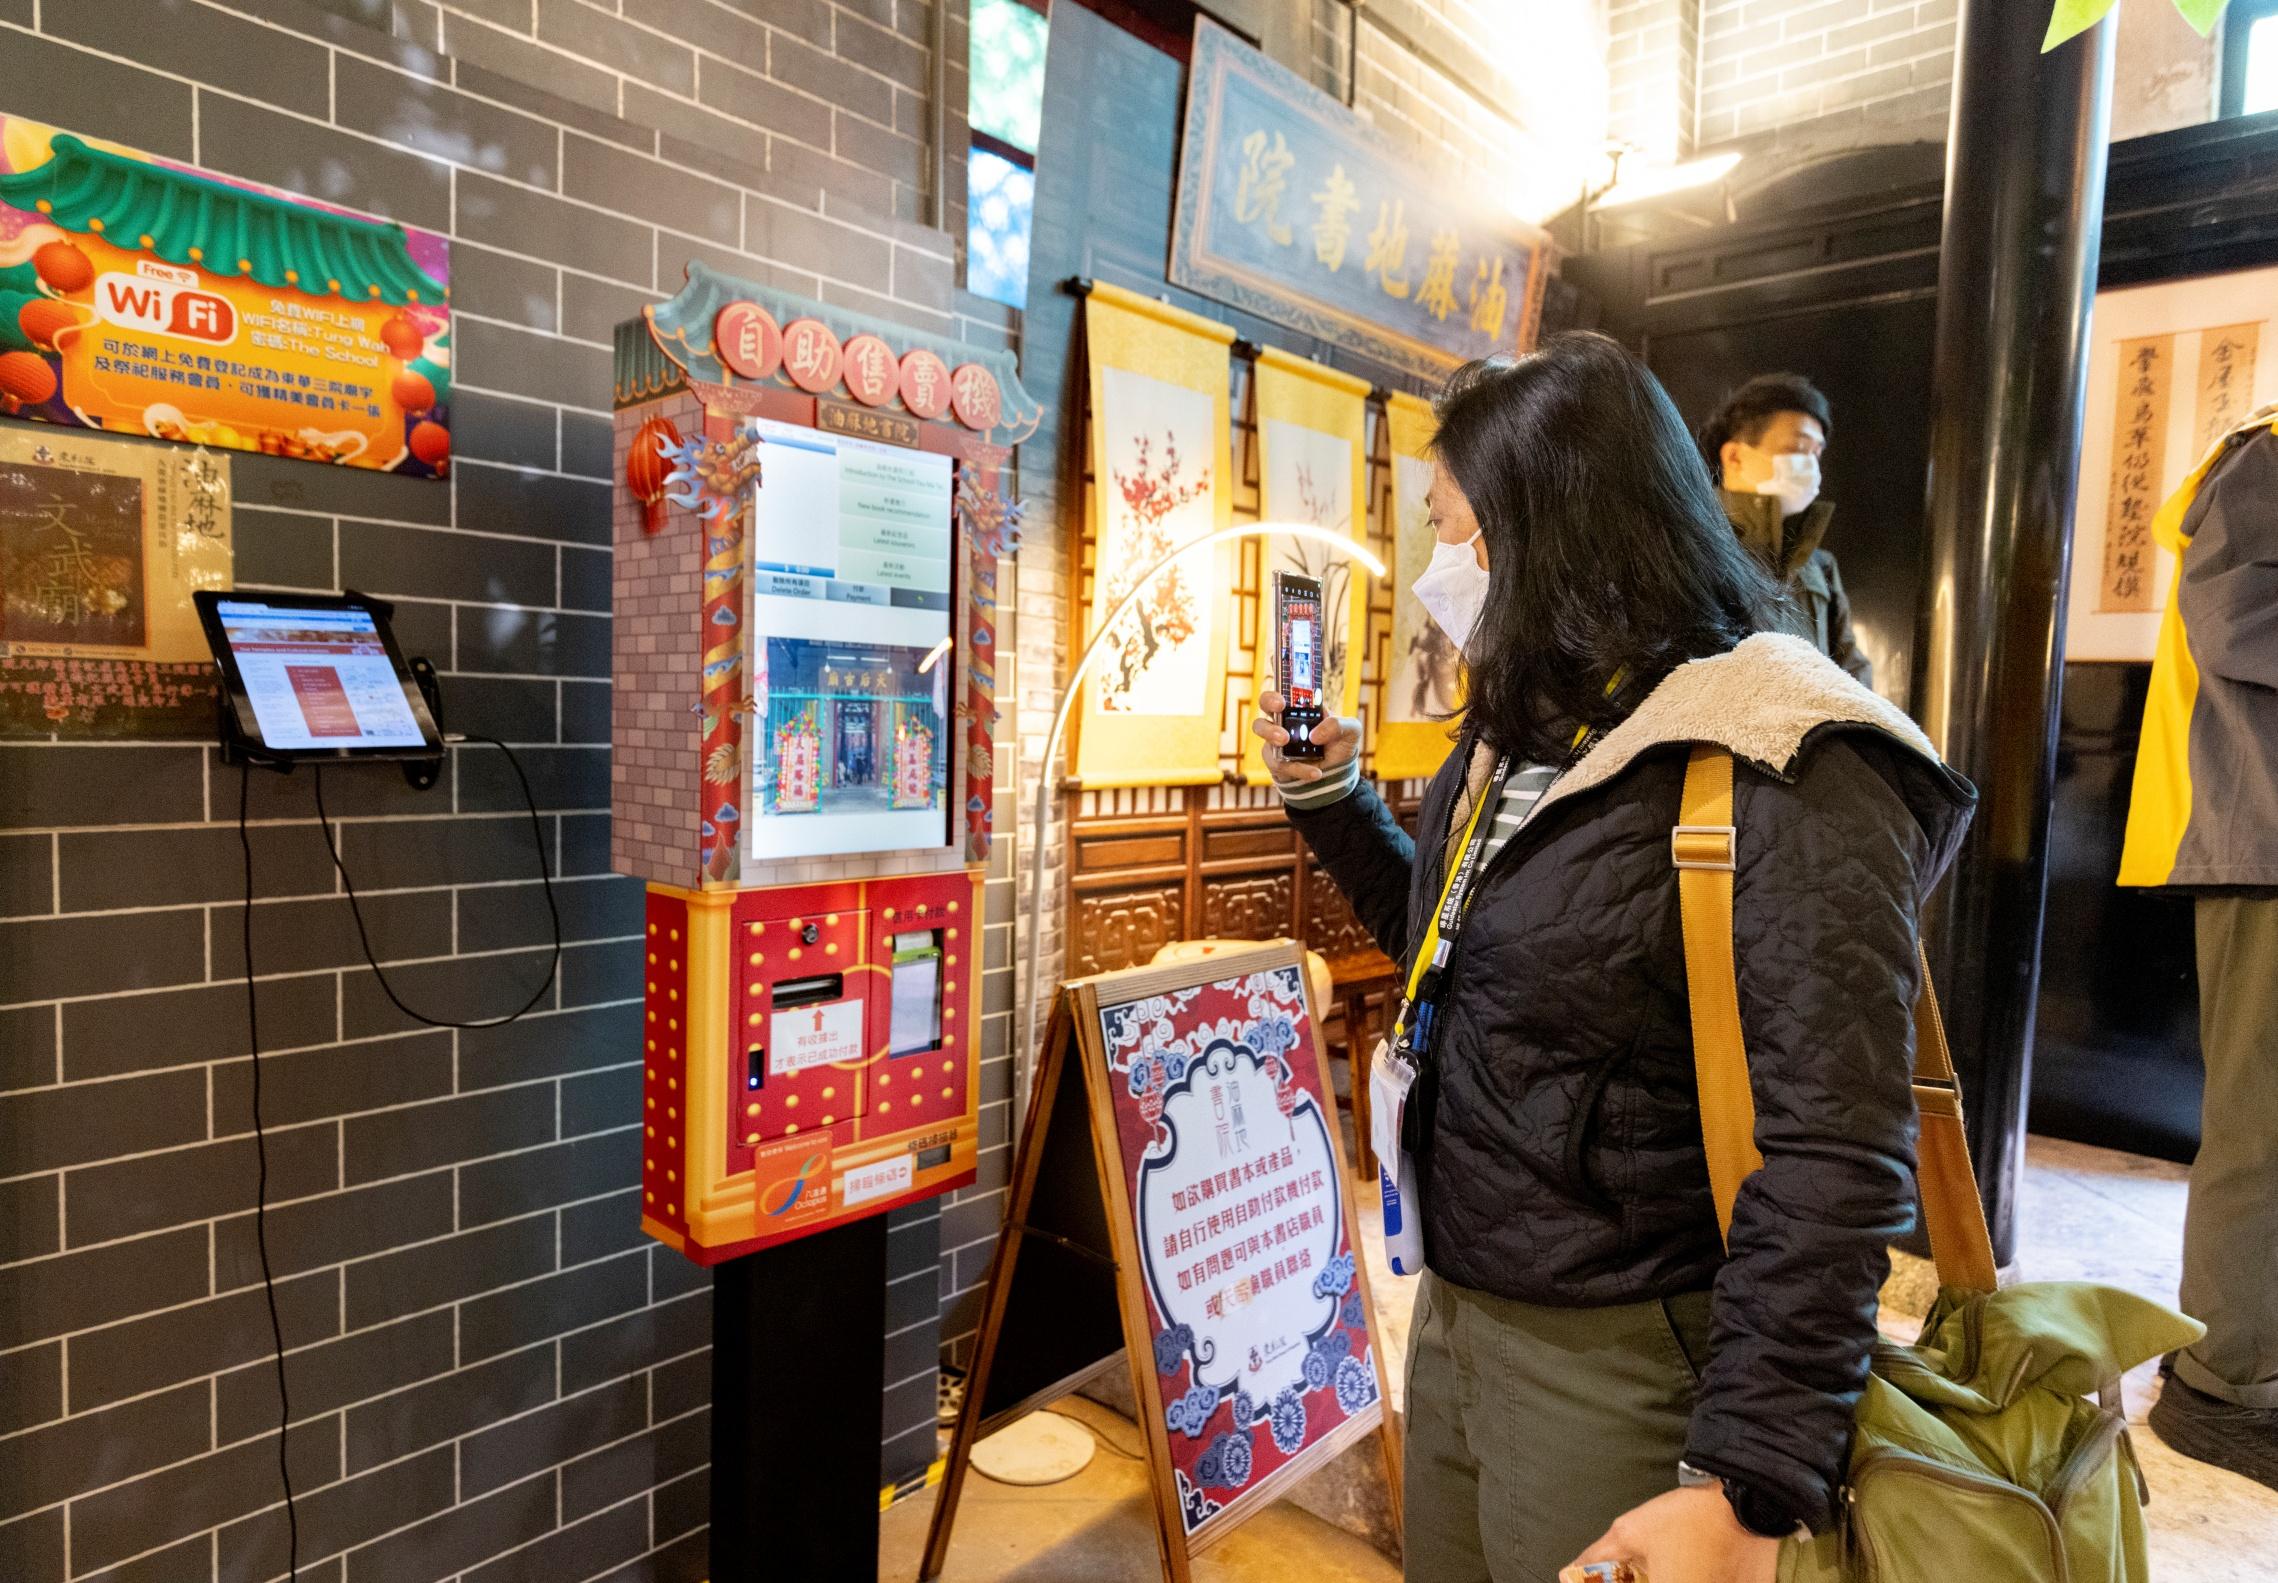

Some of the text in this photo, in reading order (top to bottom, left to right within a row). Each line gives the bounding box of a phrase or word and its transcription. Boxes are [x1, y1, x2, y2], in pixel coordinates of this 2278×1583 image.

[143, 263, 174, 279] Free
[358, 336, 392, 355] Wah
[325, 346, 379, 368] School
[737, 310, 999, 424] 自助售賣機
[846, 592, 872, 602] Payment
[794, 1196, 827, 1210] Octopus
[1162, 1169, 1325, 1259] 請自行使用自助付款機付款
[1176, 1205, 1325, 1293] 如有問題可與本書店職員
